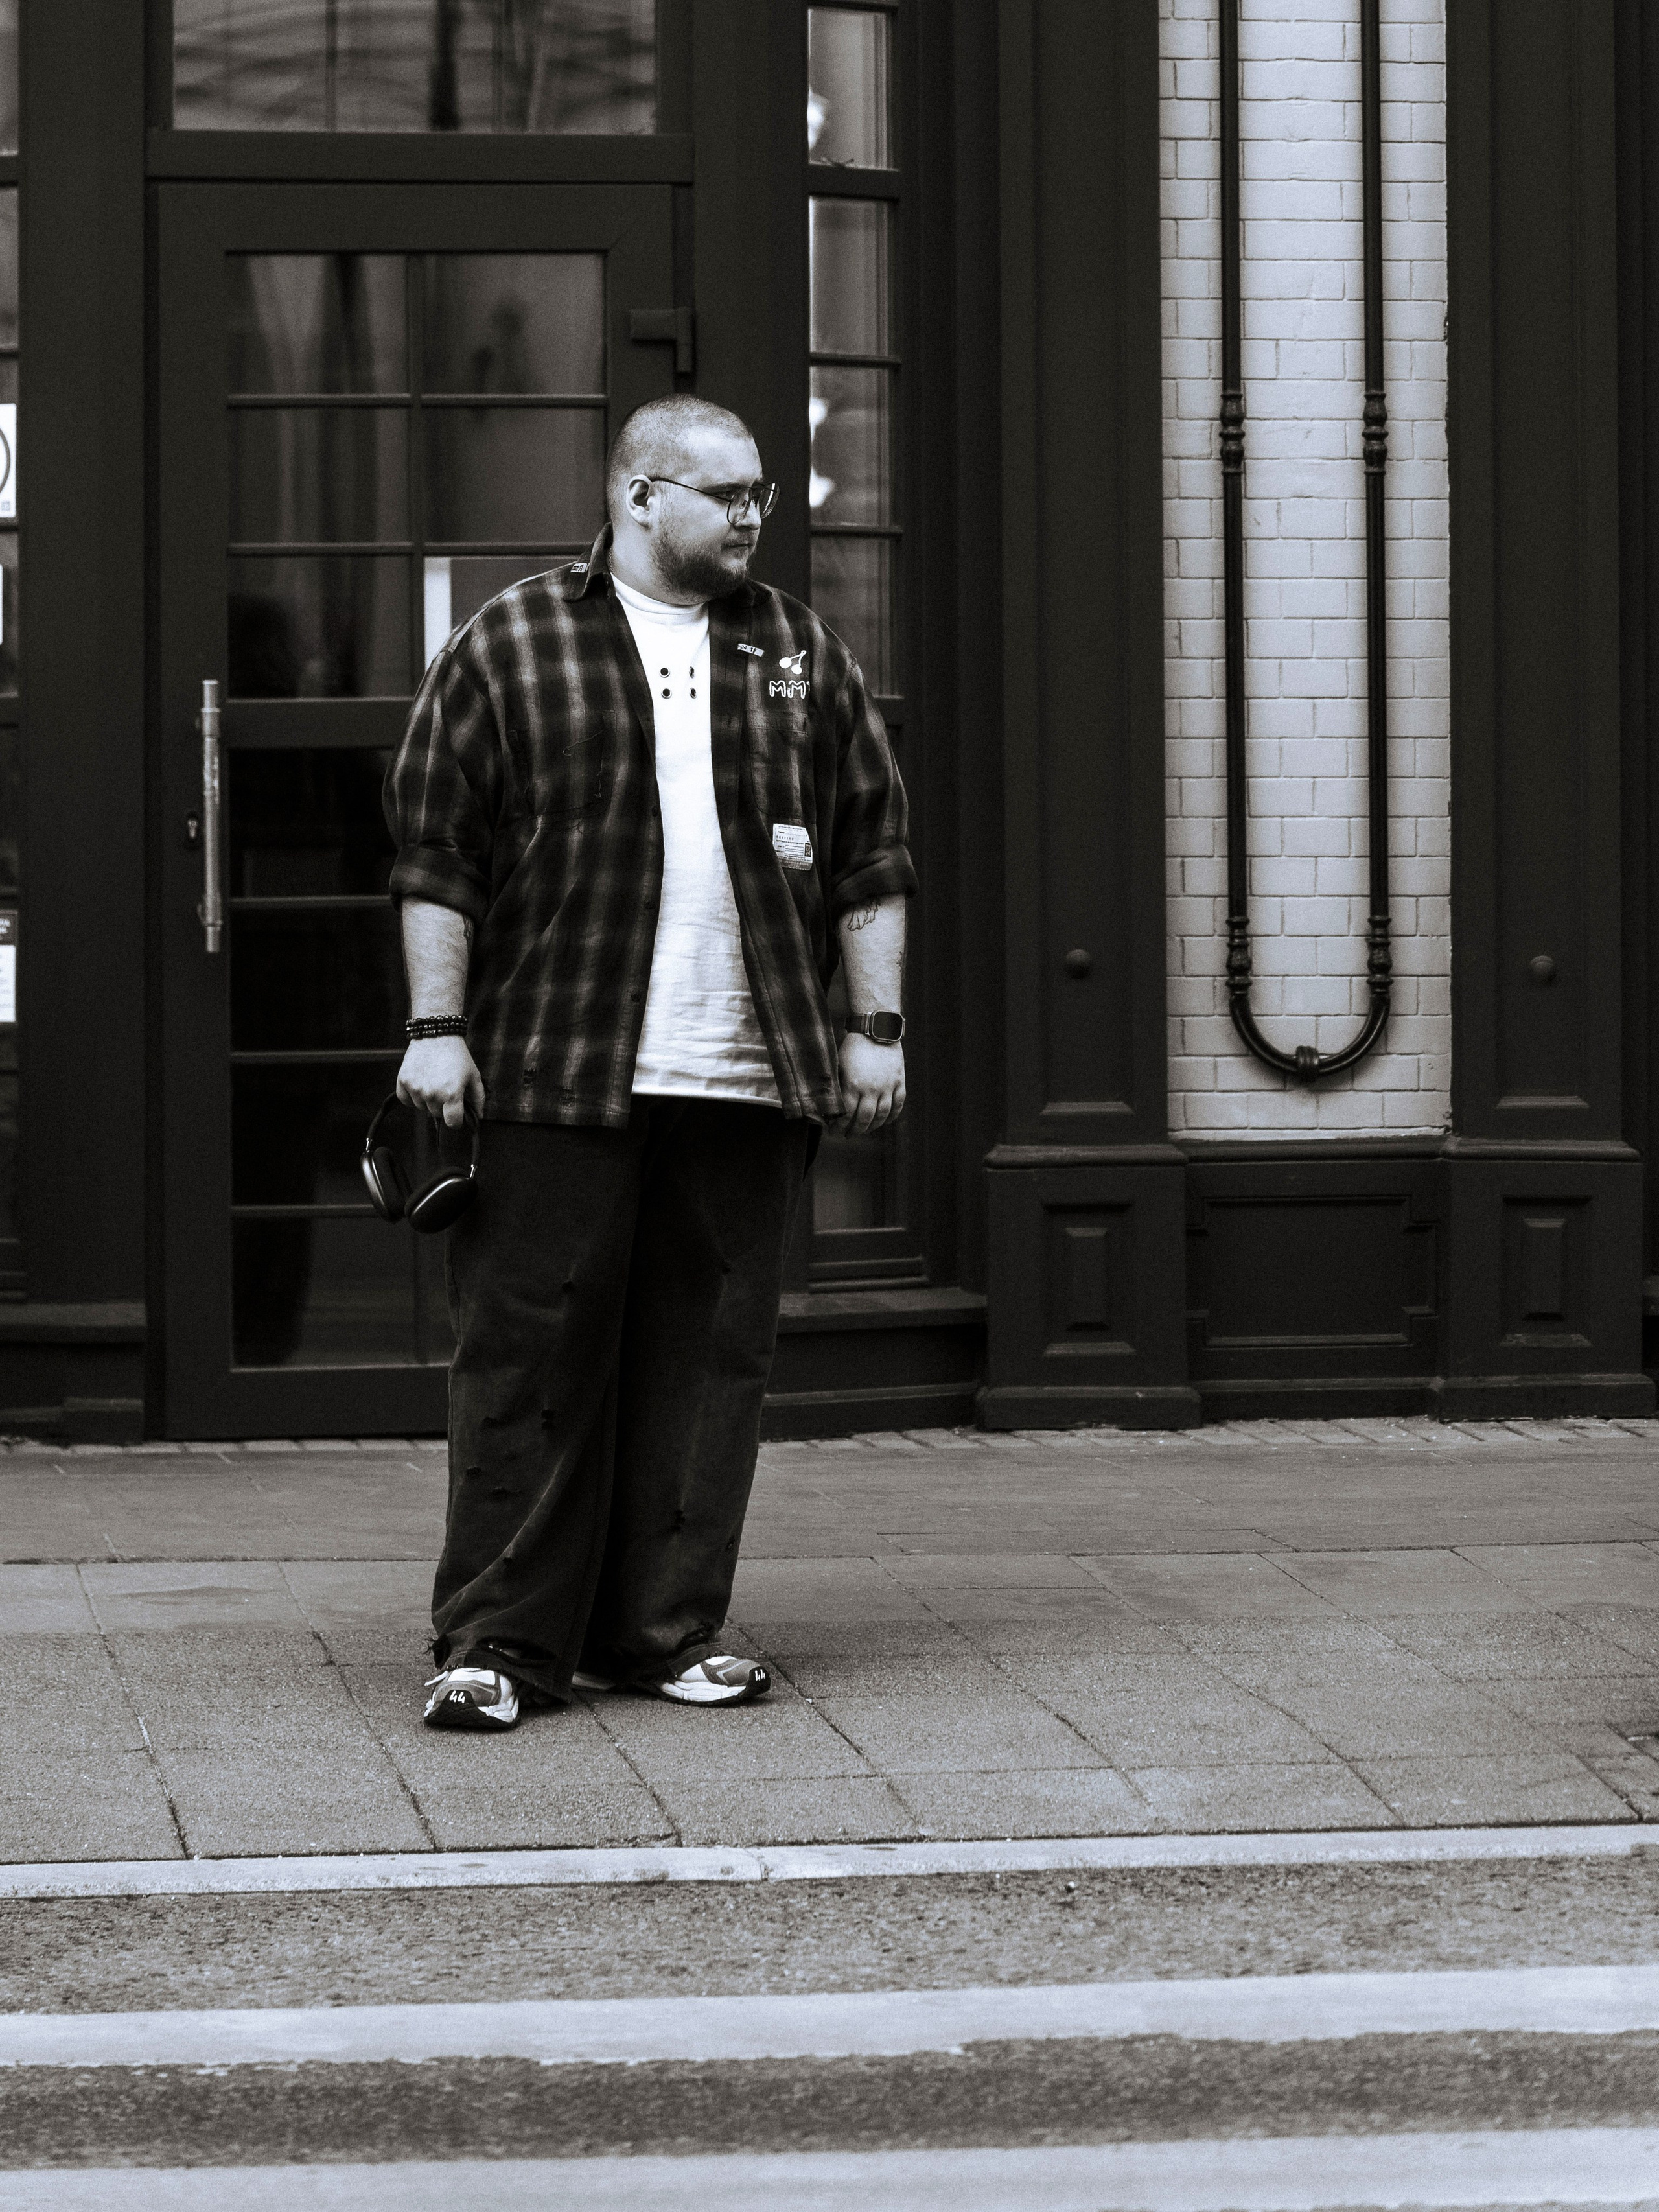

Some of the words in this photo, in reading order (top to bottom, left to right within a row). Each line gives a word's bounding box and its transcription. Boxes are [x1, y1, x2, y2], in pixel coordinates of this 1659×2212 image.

[769, 680, 810, 699] MM
[755, 1668, 765, 1681] 44
[449, 1690, 465, 1704] 44
